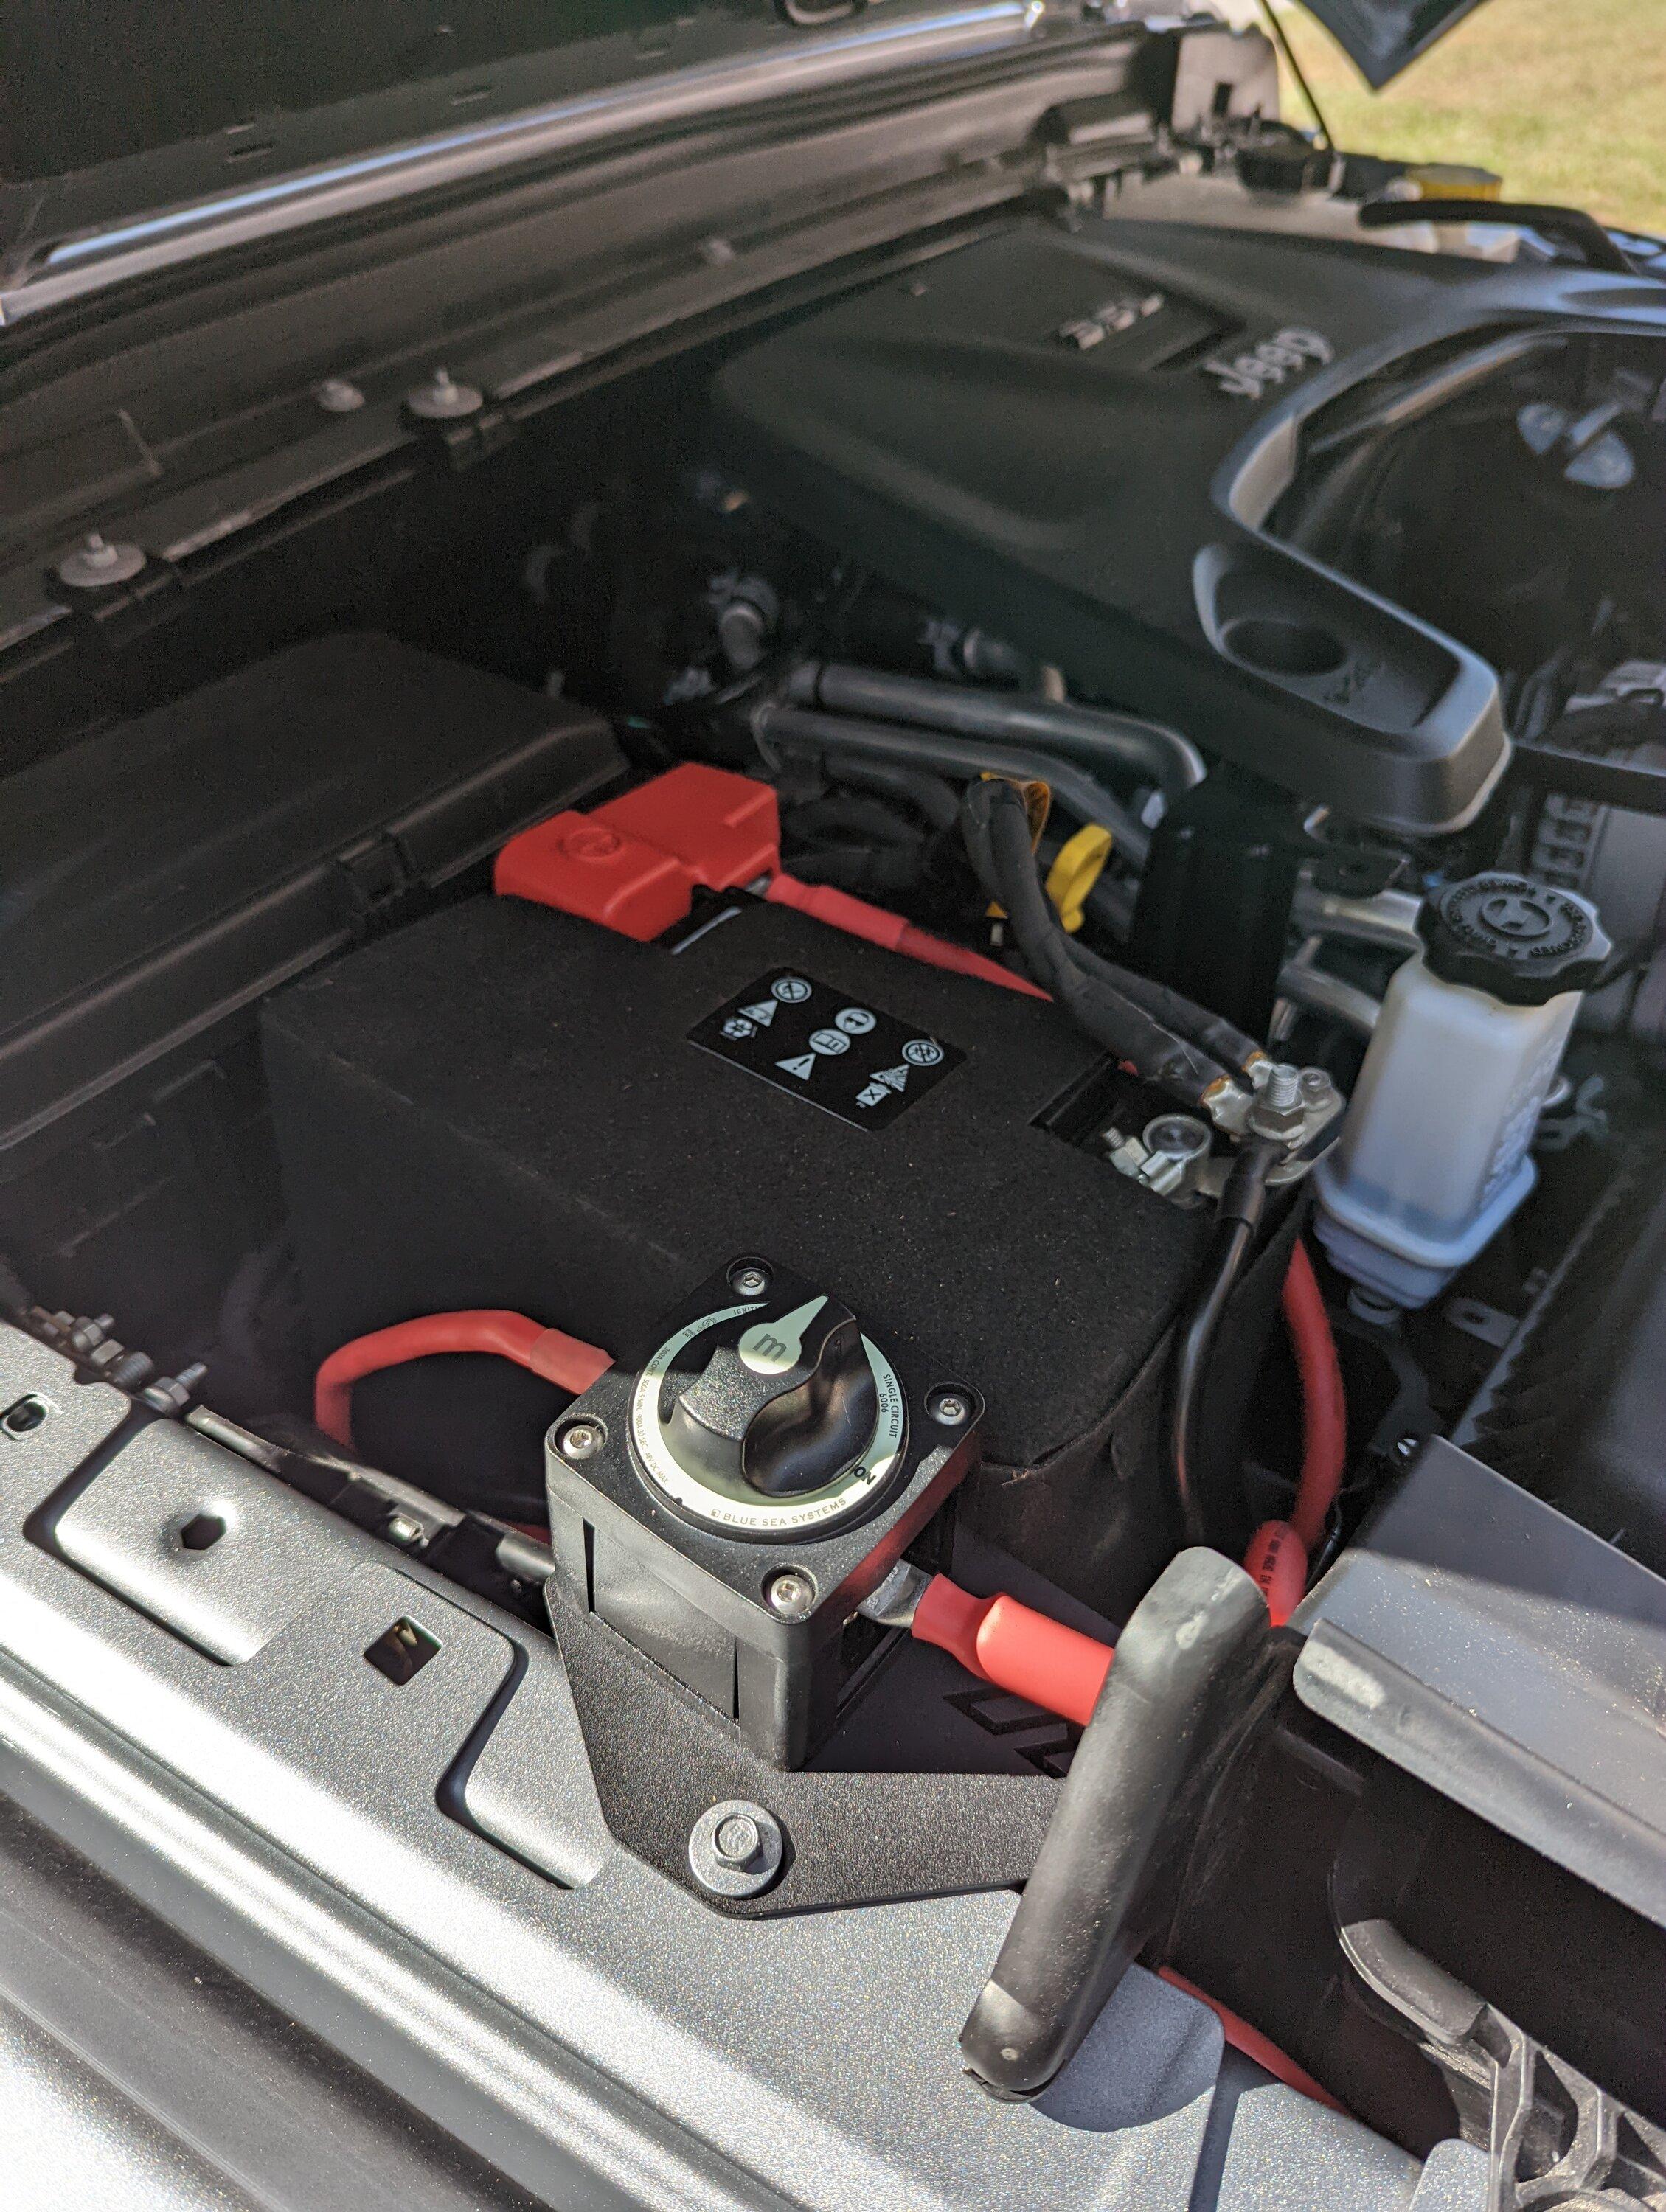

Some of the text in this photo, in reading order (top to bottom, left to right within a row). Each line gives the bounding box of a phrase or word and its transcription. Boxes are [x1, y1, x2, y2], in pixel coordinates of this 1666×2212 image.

[1201, 327, 1336, 401] Jeep
[656, 1346, 671, 1360] 300A
[752, 1333, 787, 1363] m
[879, 1393, 889, 1413] 6006
[883, 1374, 900, 1439] SINGLE CIRCUIT
[853, 1466, 877, 1486] ON
[723, 1498, 847, 1526] BLUE SEA SYSTEMS
